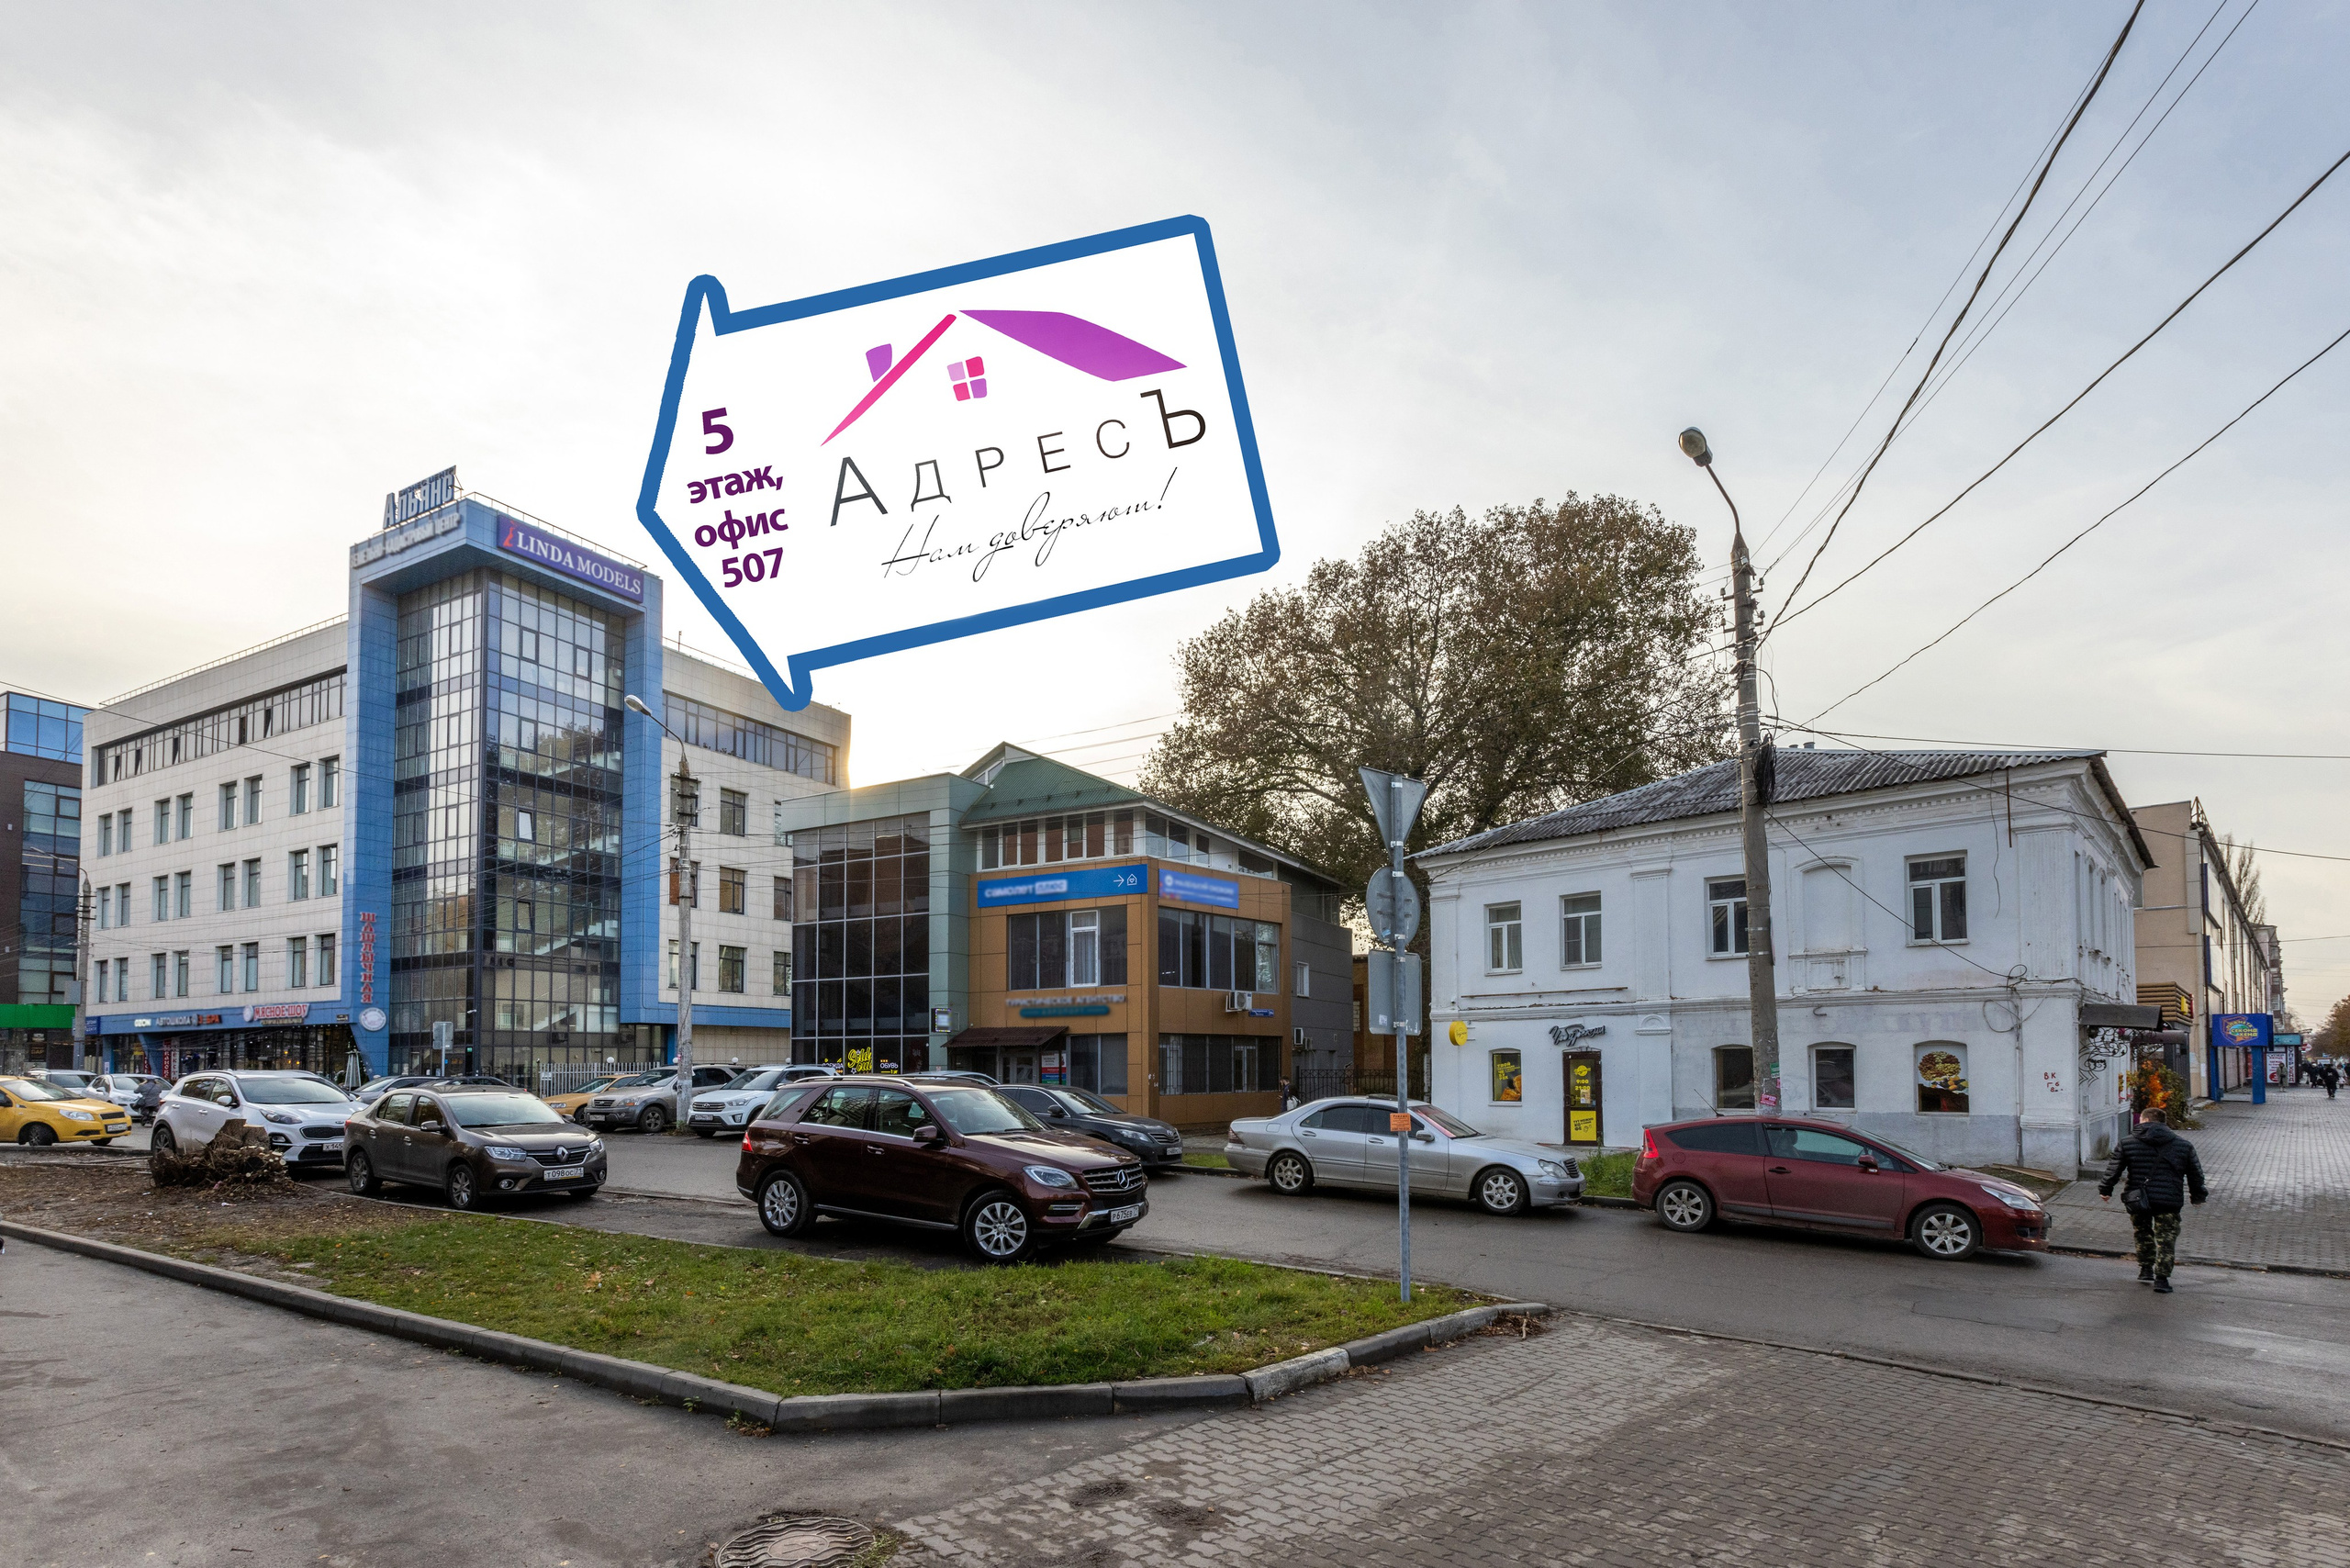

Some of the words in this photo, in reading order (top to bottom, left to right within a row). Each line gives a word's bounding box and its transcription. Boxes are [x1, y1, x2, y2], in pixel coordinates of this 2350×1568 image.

[517, 531, 574, 569] LINDA
[576, 555, 641, 595] MODELS
[360, 912, 376, 1003] ШАШЛЫЧНАЯ
[155, 1016, 192, 1027] АВТОШКОЛА
[254, 1005, 285, 1019] МЯСНОЕ
[287, 1004, 308, 1016] ШОУ
[847, 1047, 872, 1068] Sold
